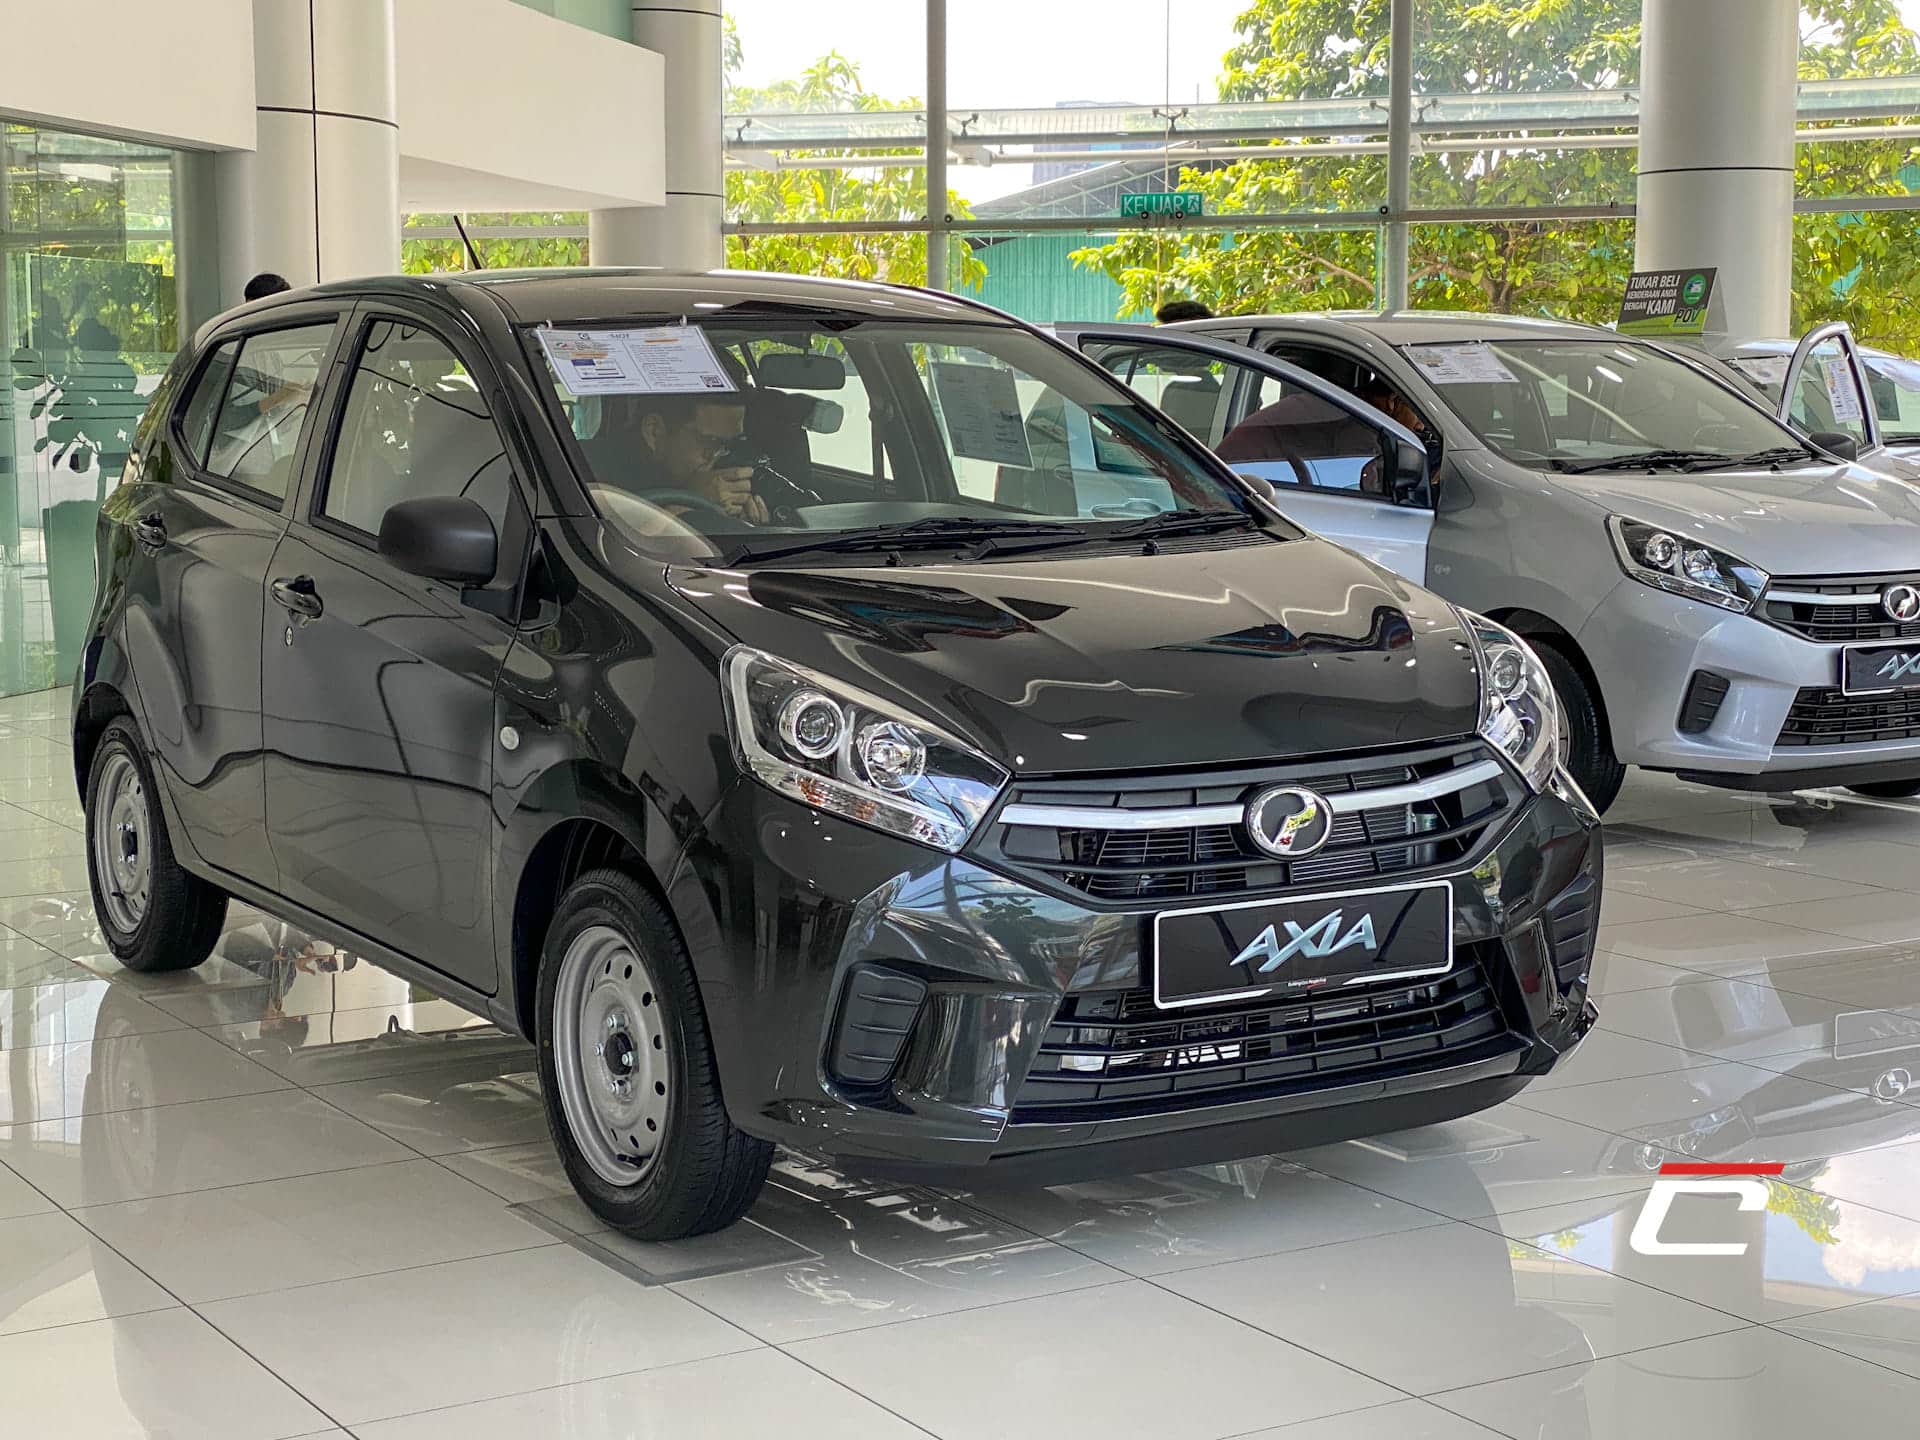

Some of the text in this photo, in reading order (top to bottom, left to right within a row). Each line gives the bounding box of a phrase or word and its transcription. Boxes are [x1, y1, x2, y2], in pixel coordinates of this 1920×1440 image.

[1123, 194, 1184, 214] KELUAR
[1630, 274, 1680, 289] TUKAR BELI
[1646, 299, 1676, 315] KAMI
[1876, 652, 1920, 680] AX
[1229, 908, 1378, 973] AXIA
